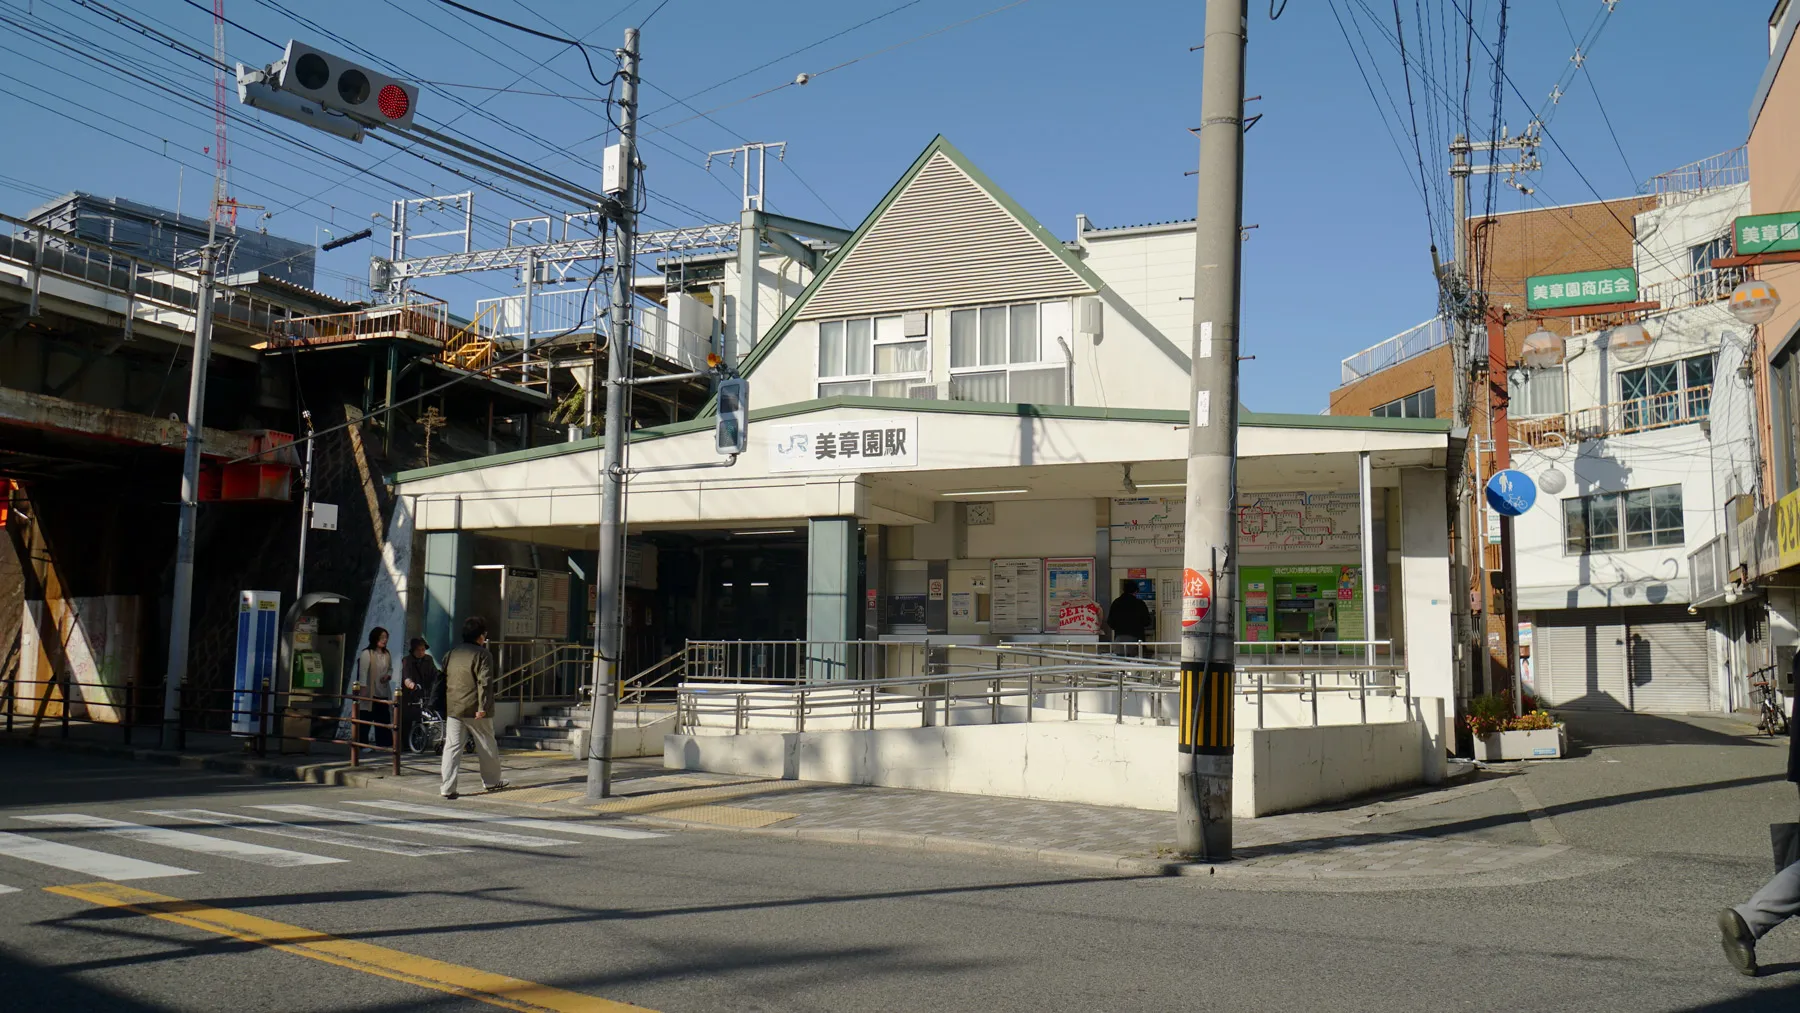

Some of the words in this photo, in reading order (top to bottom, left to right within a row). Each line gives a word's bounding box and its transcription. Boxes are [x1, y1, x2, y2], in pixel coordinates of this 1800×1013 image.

[1742, 223, 1799, 245] 美章園
[1533, 277, 1630, 301] 美章園商店会
[778, 434, 809, 455] JR
[815, 427, 907, 460] 美章園駅
[1059, 604, 1085, 618] GET!
[1059, 614, 1085, 627] HAPPY!
